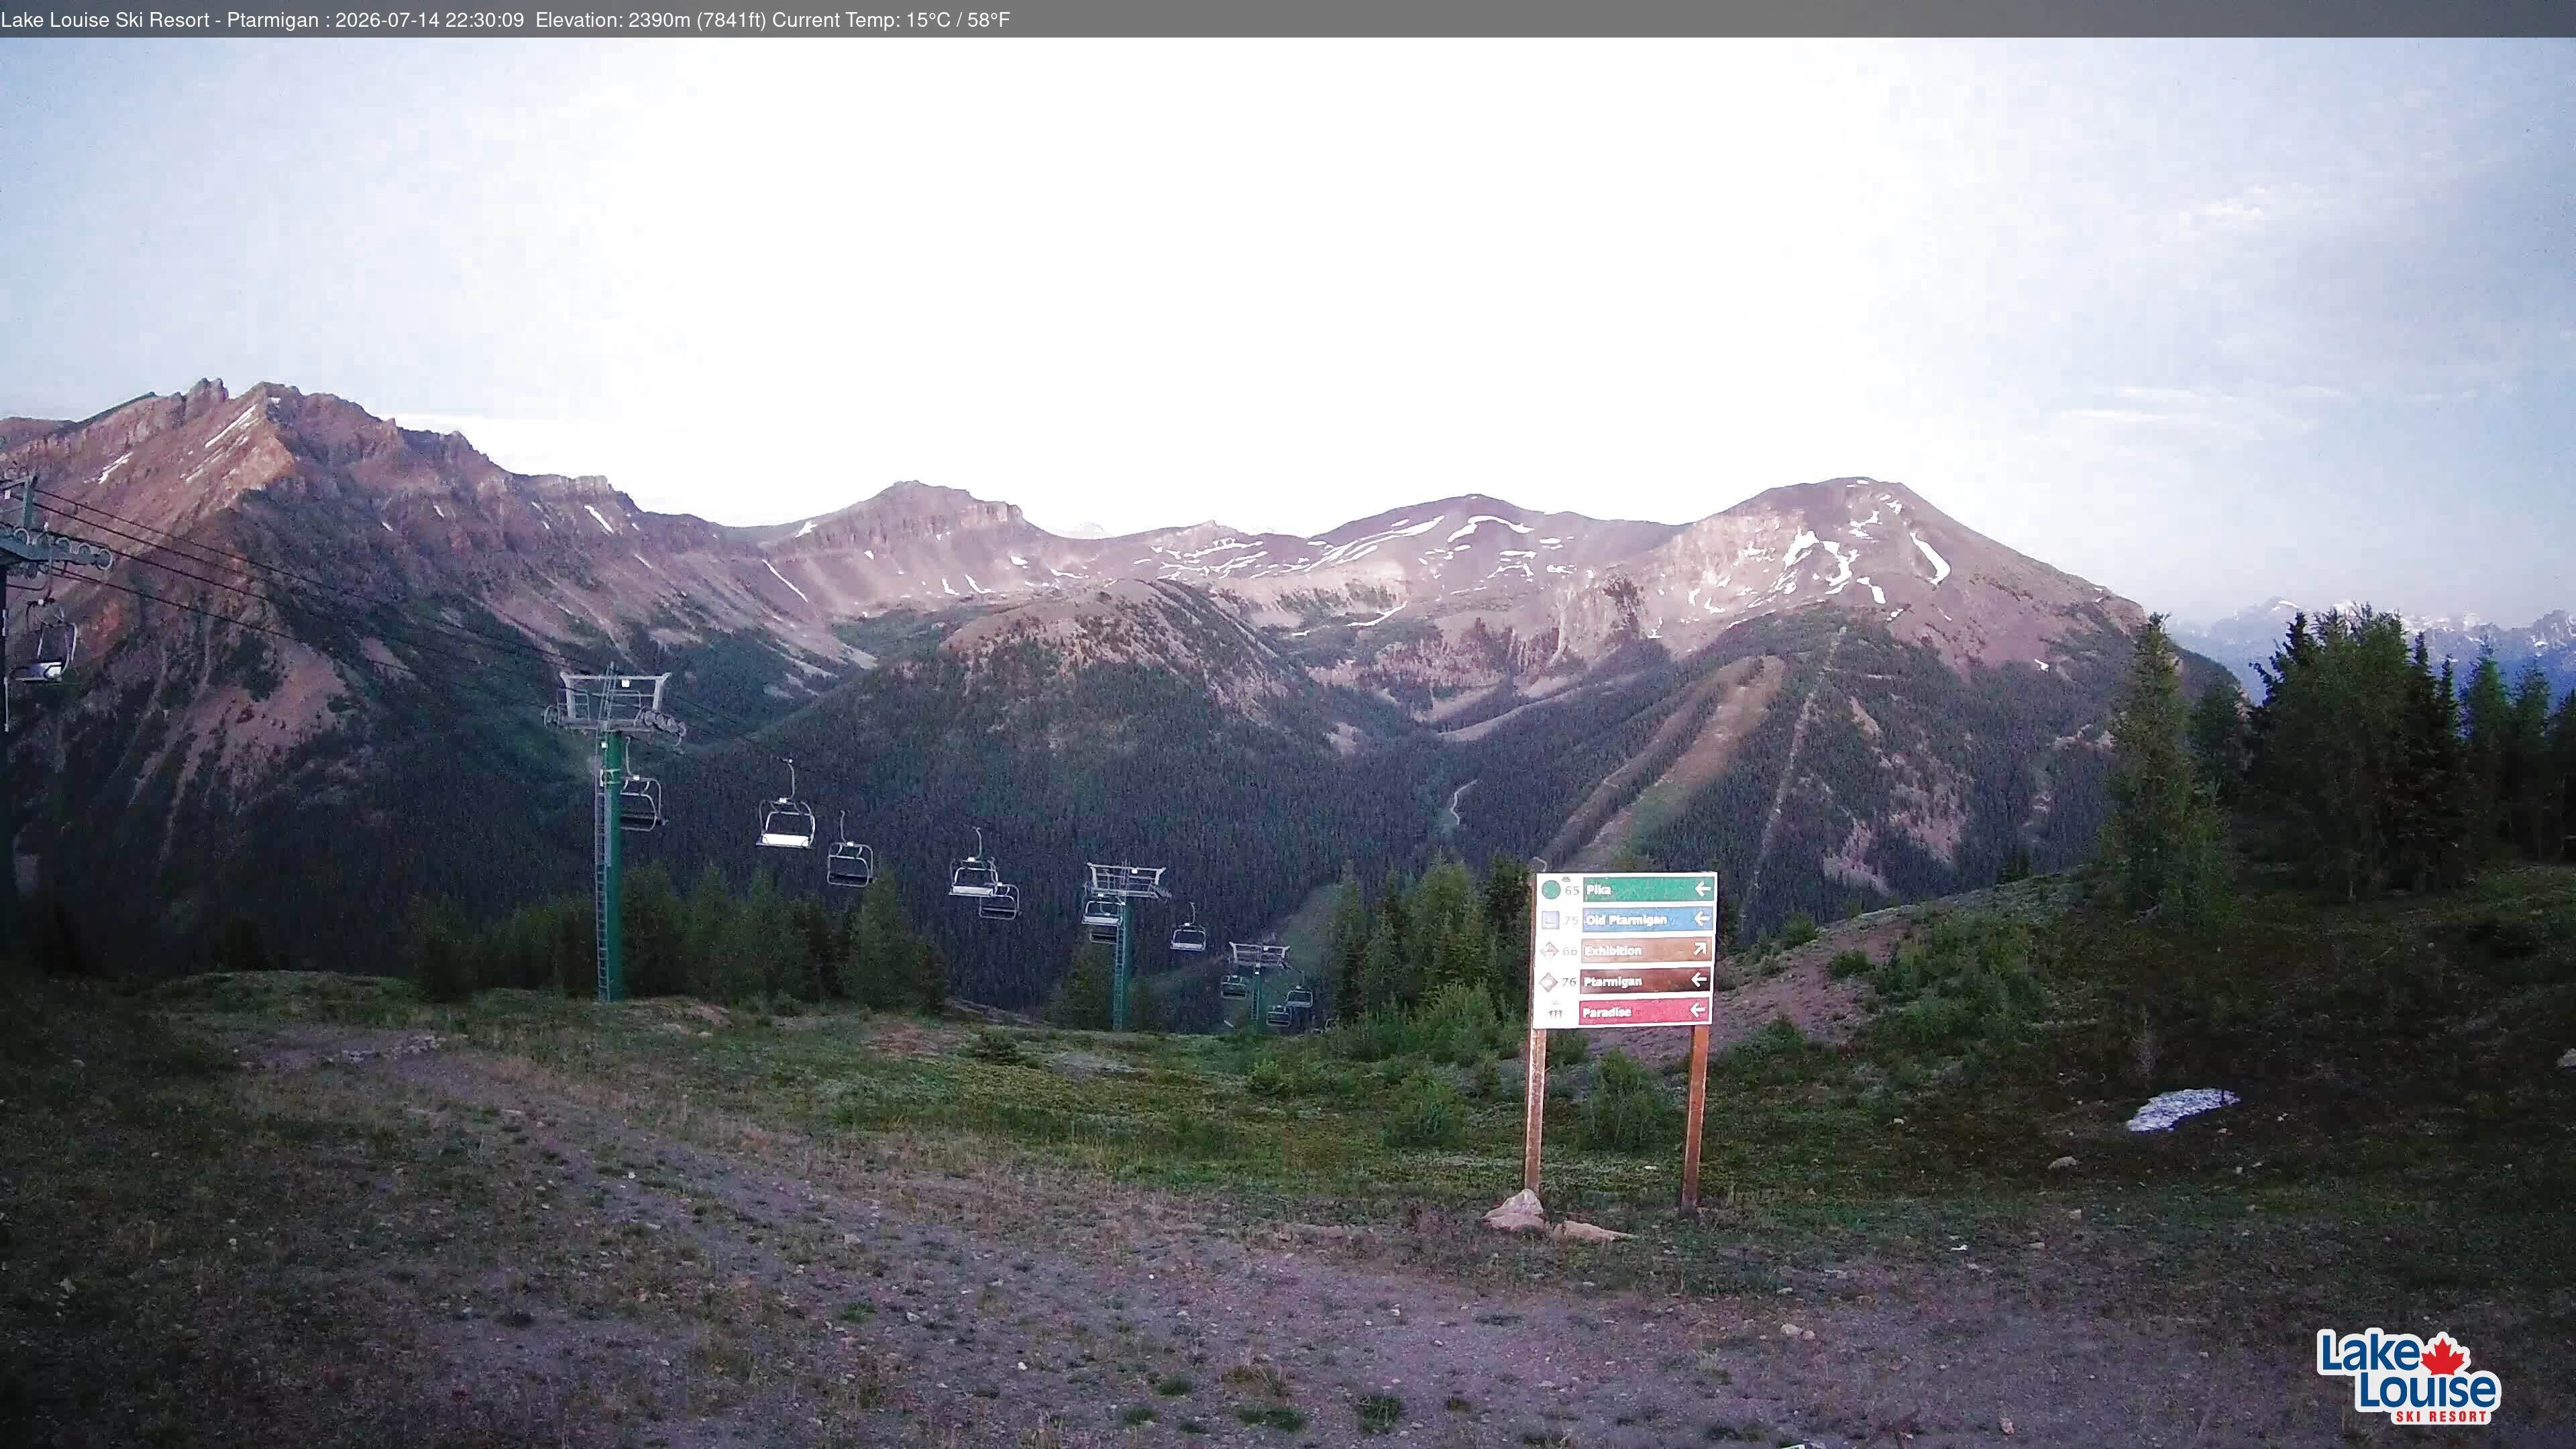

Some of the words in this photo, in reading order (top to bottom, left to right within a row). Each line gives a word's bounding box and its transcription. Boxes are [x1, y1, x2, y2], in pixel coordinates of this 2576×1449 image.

[1564, 885, 1580, 896] 65
[1587, 884, 1611, 895] Pika
[1564, 916, 1578, 926] 75
[1586, 914, 1606, 926] Old
[1609, 914, 1668, 927] Ptarmigan
[1584, 945, 1642, 956] Exhibition
[1561, 977, 1577, 987] 76
[1584, 976, 1643, 989] Ptarmigan
[1582, 1006, 1632, 1018] Paradise
